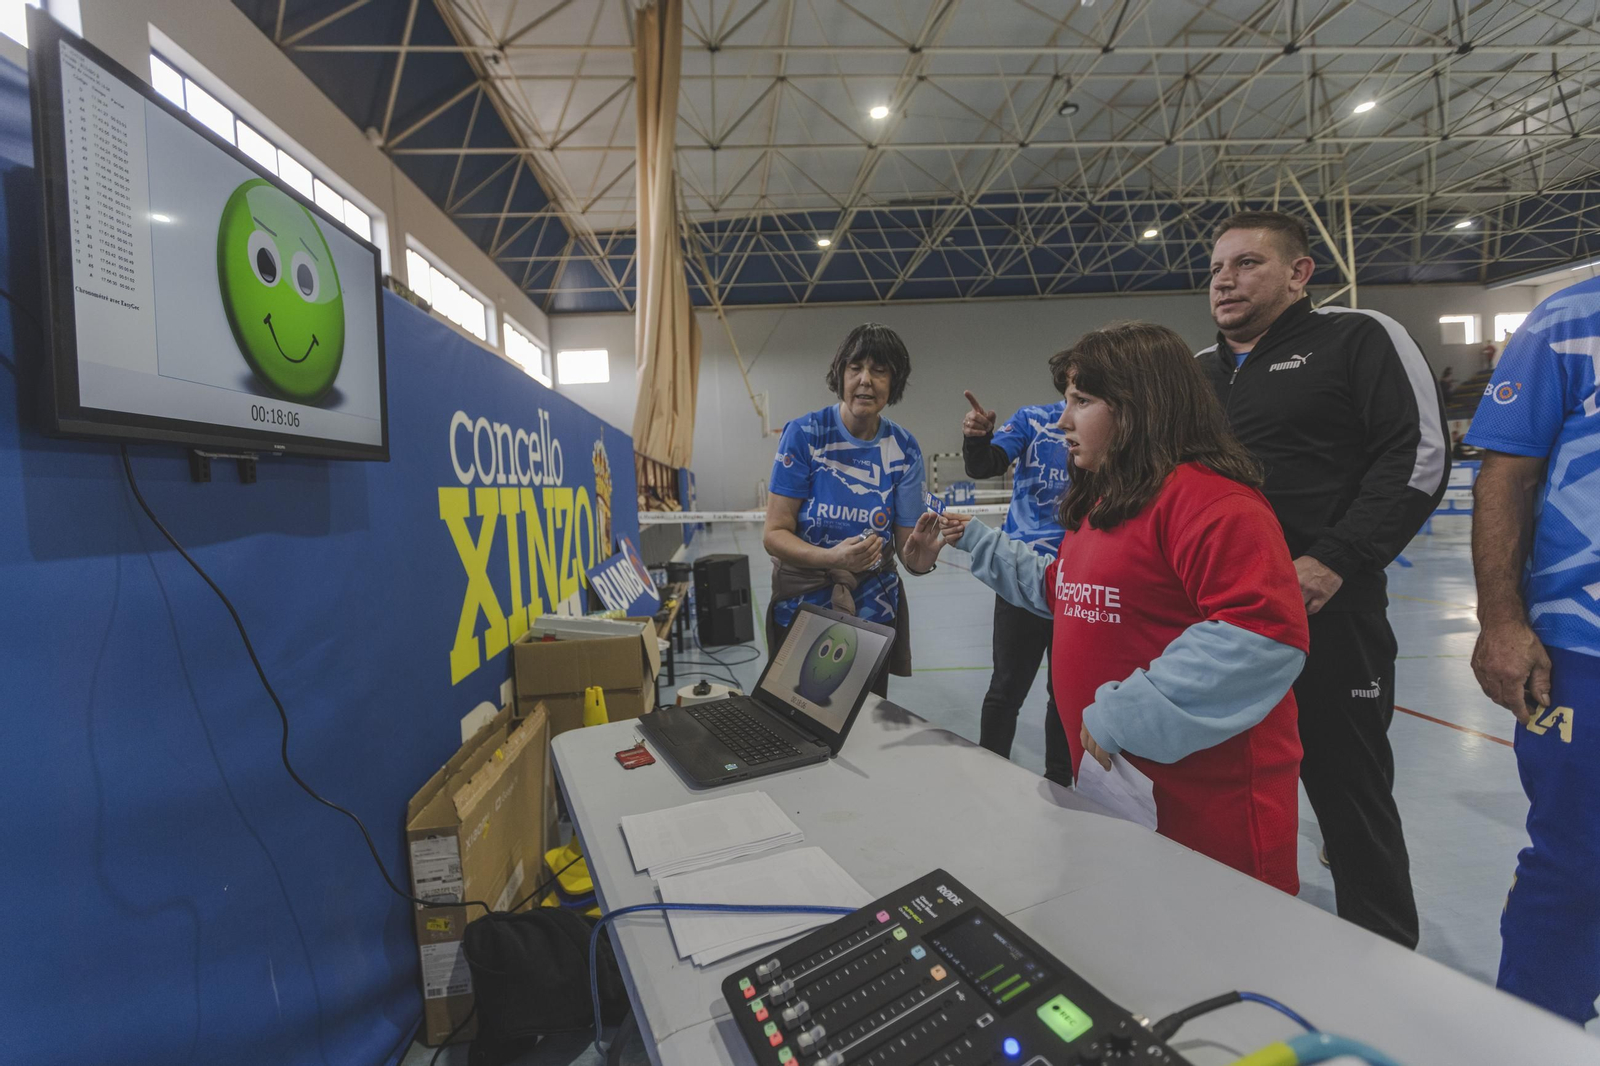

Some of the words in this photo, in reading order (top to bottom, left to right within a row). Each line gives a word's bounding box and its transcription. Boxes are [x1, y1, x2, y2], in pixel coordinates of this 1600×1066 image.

[1269, 360, 1301, 372] PUMA
[251, 404, 300, 428] 00:18:06
[450, 408, 563, 486] concello
[438, 485, 595, 686] XINZO
[1064, 603, 1073, 617] La
[1074, 604, 1121, 624] Región
[1060, 1011, 1077, 1026] REC
